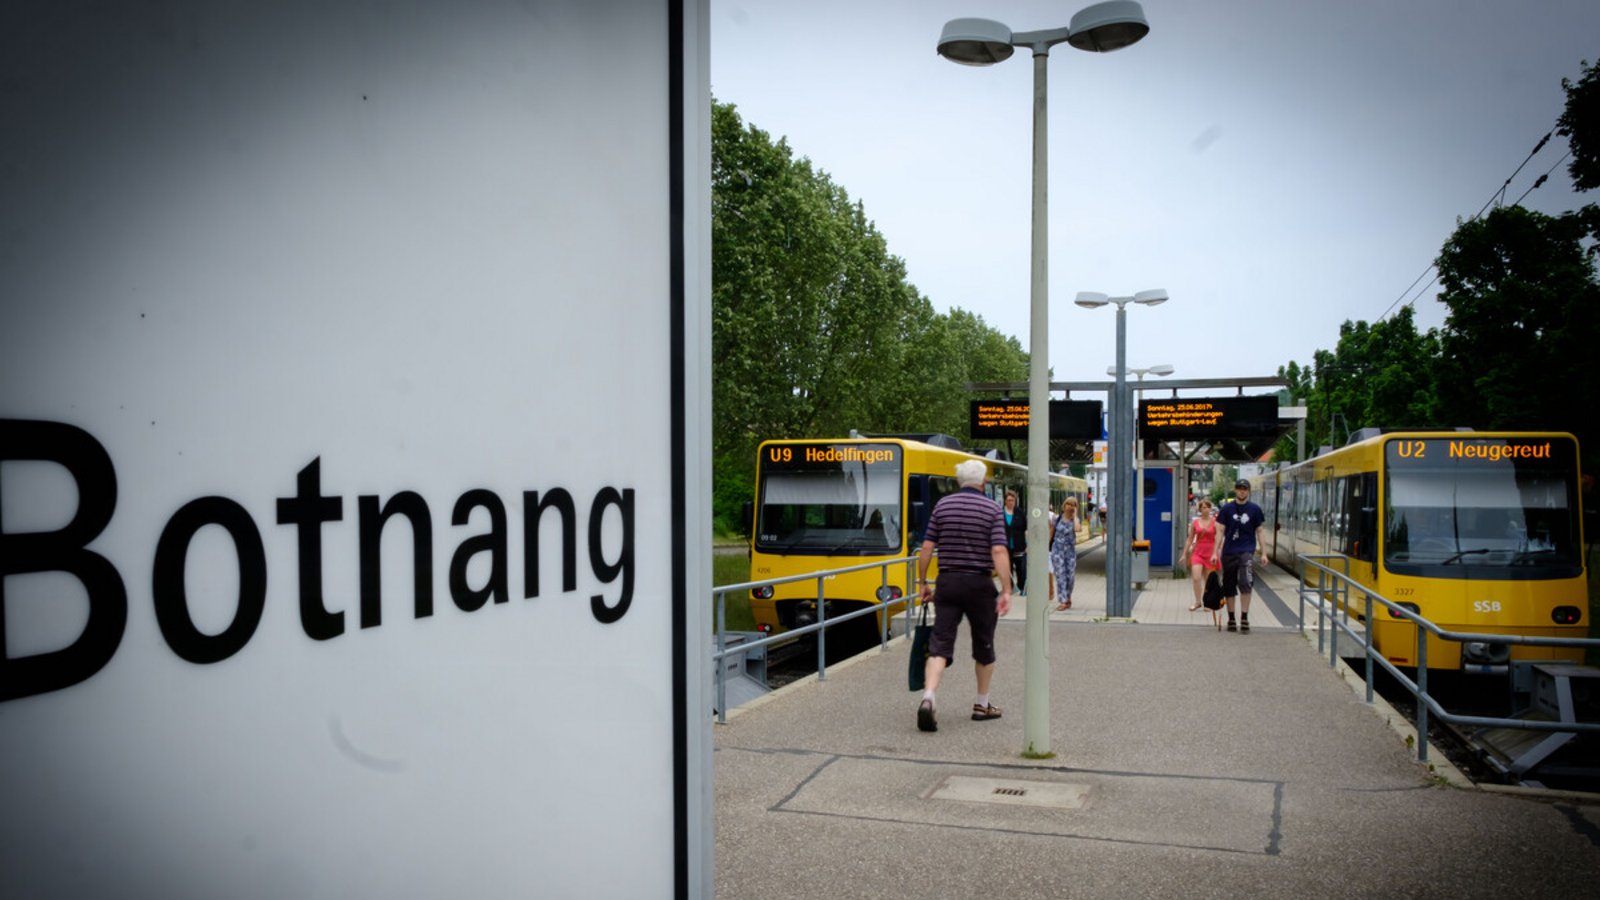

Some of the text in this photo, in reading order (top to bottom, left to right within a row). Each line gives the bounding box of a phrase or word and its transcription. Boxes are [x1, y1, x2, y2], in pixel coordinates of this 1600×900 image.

[770, 447, 893, 464] U9 Hedelfingen
[1398, 440, 1551, 461] U2 Neugereut
[0, 418, 636, 702] Botnang
[1394, 588, 1415, 596] 3327
[1473, 600, 1502, 613] SSB
